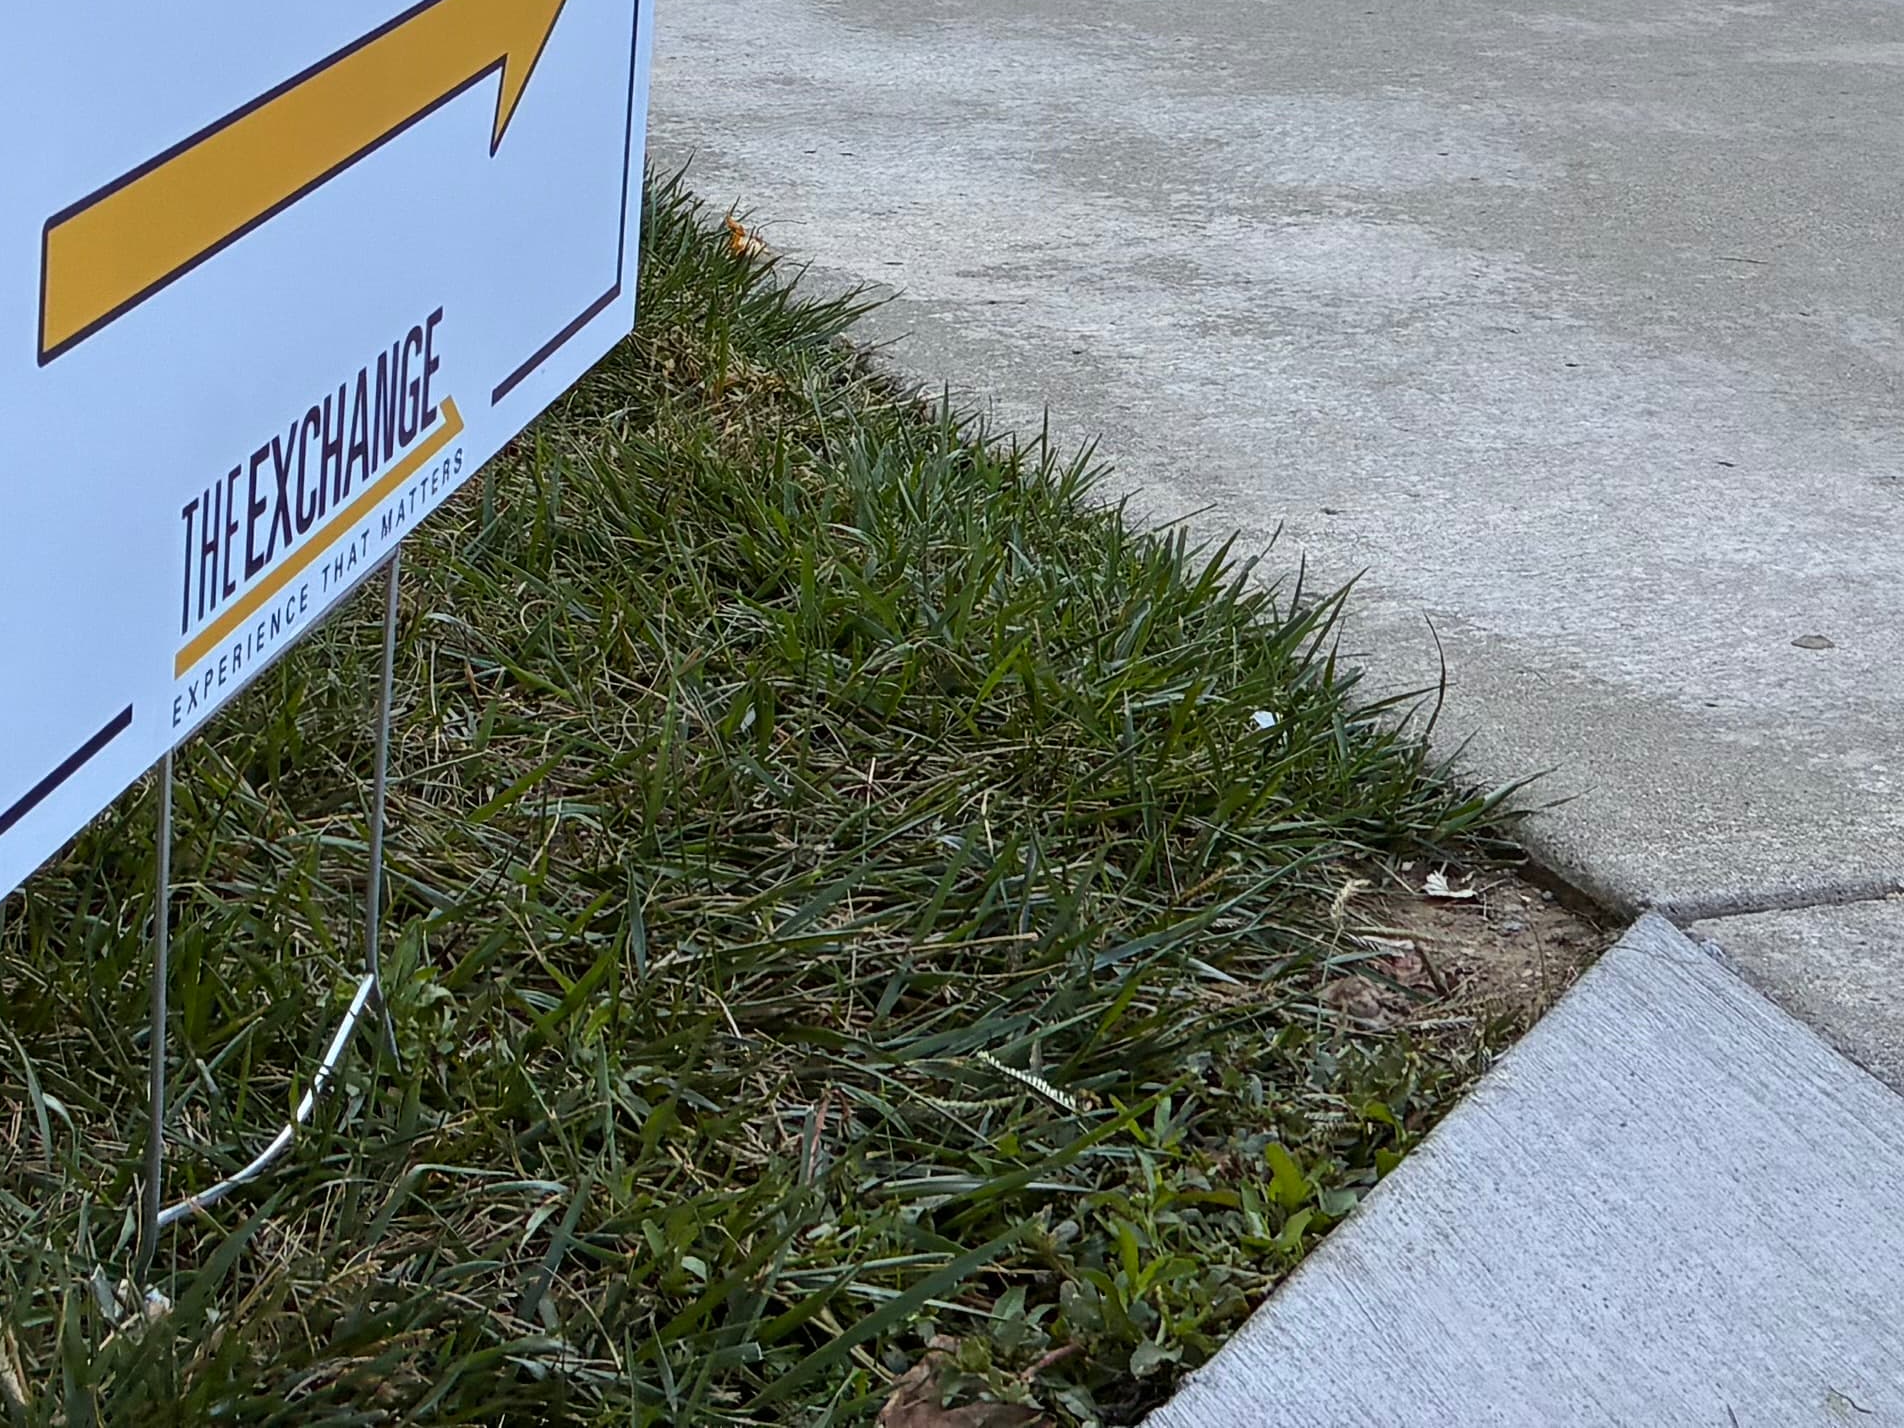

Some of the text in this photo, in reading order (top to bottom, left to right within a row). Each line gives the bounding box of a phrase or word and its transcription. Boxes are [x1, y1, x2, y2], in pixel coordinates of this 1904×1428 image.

[172, 447, 464, 729] EXPERIENCE THAT MATTERS
